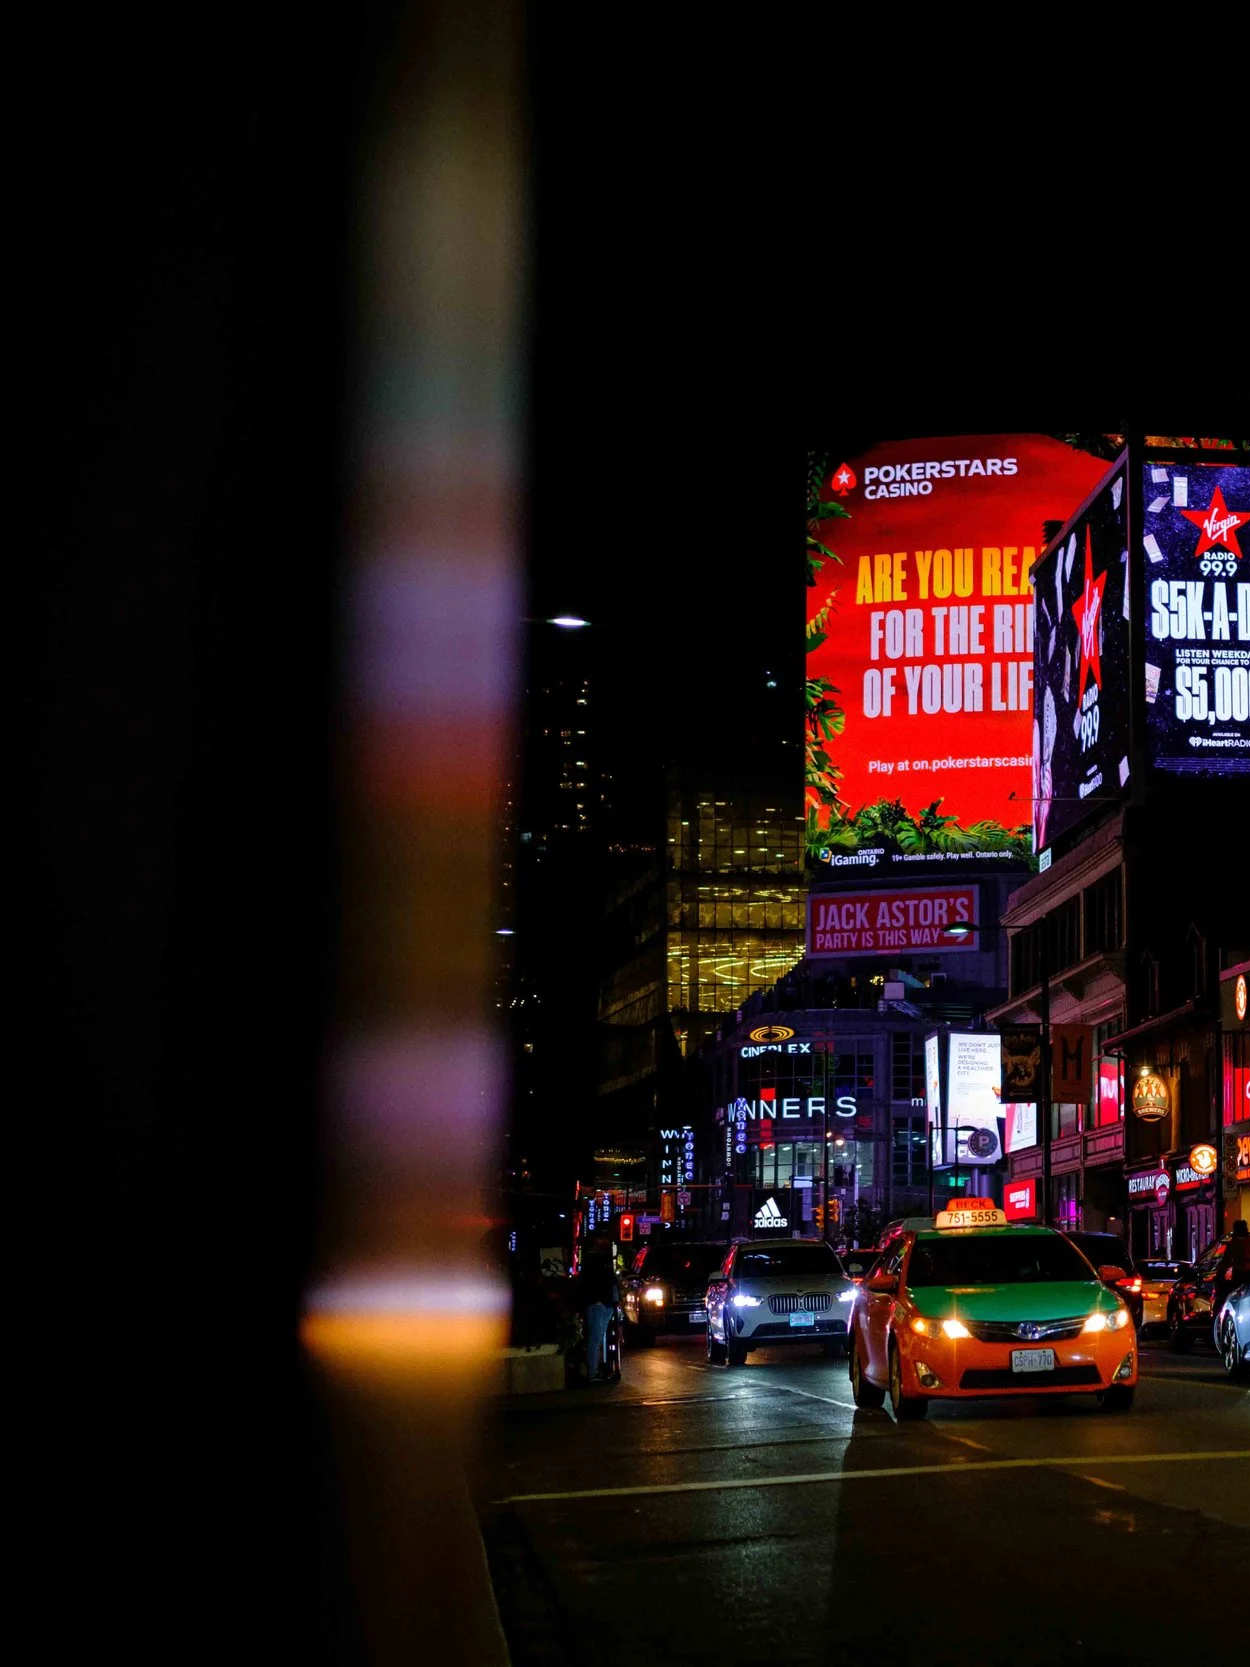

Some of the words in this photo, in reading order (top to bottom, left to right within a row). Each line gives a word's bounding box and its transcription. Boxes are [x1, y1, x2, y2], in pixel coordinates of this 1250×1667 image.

[864, 457, 1018, 485] POKERSTARS
[864, 481, 933, 500] CASINO
[1203, 508, 1240, 542] Virgin
[1203, 552, 1236, 561] RADIO
[855, 553, 908, 605] ARE
[915, 548, 974, 600] YOU
[982, 547, 1047, 597] REA
[1200, 560, 1238, 577] 99.9
[870, 607, 925, 661] FOR
[931, 605, 986, 656] THE
[1176, 649, 1210, 658] LISTEN
[863, 667, 896, 719] OF
[904, 662, 984, 716] YOUR
[868, 760, 895, 775] Play
[897, 760, 910, 772] at
[816, 902, 871, 931] JACK
[876, 897, 969, 928] ASTOR'S
[816, 931, 859, 949] PARTY
[861, 931, 874, 947] IS
[876, 929, 908, 946] THIS
[910, 927, 941, 945] WAY
[727, 1096, 857, 1123] WNNERS
[754, 1216, 788, 1228] adidas
[948, 1210, 998, 1224] 751-5555
